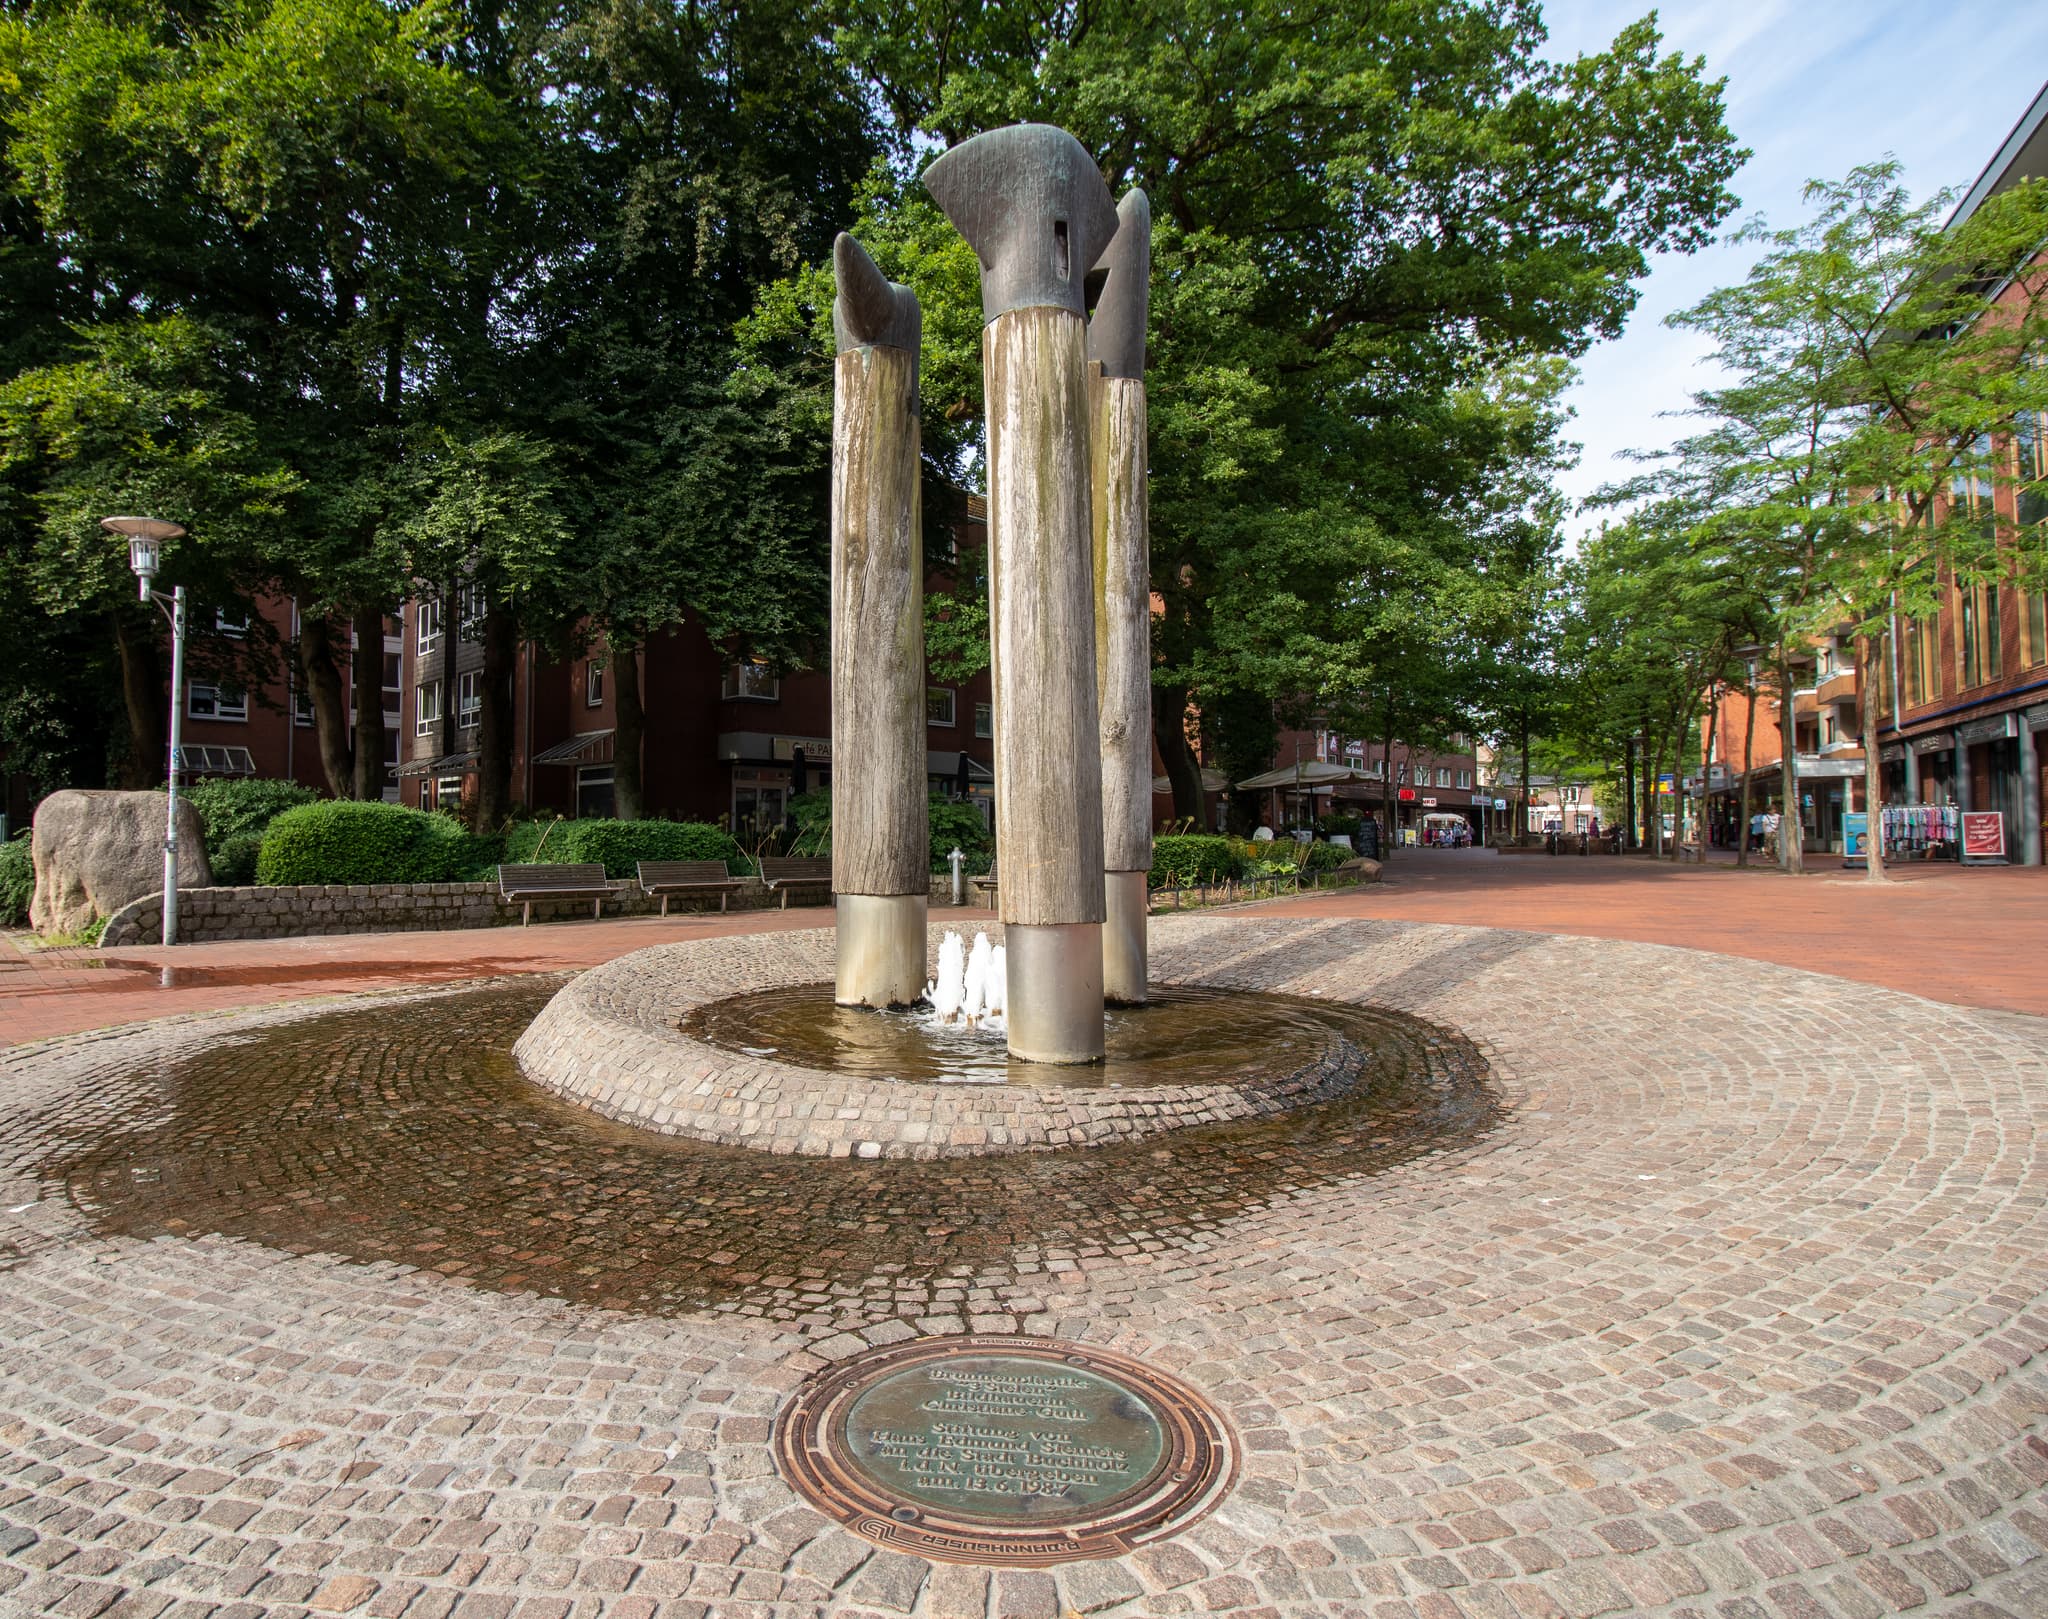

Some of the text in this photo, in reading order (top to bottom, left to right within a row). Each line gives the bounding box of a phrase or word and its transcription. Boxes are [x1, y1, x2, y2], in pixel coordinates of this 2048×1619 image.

[793, 742, 816, 754] Cfé
[922, 1400, 1028, 1417] Christiane
[932, 1423, 1072, 1443] Stiftung von
[870, 1431, 1129, 1459] Hans Edmund Siemers
[879, 1445, 1130, 1473] an die Stadt Buchholz
[974, 1463, 1099, 1486] übergeben
